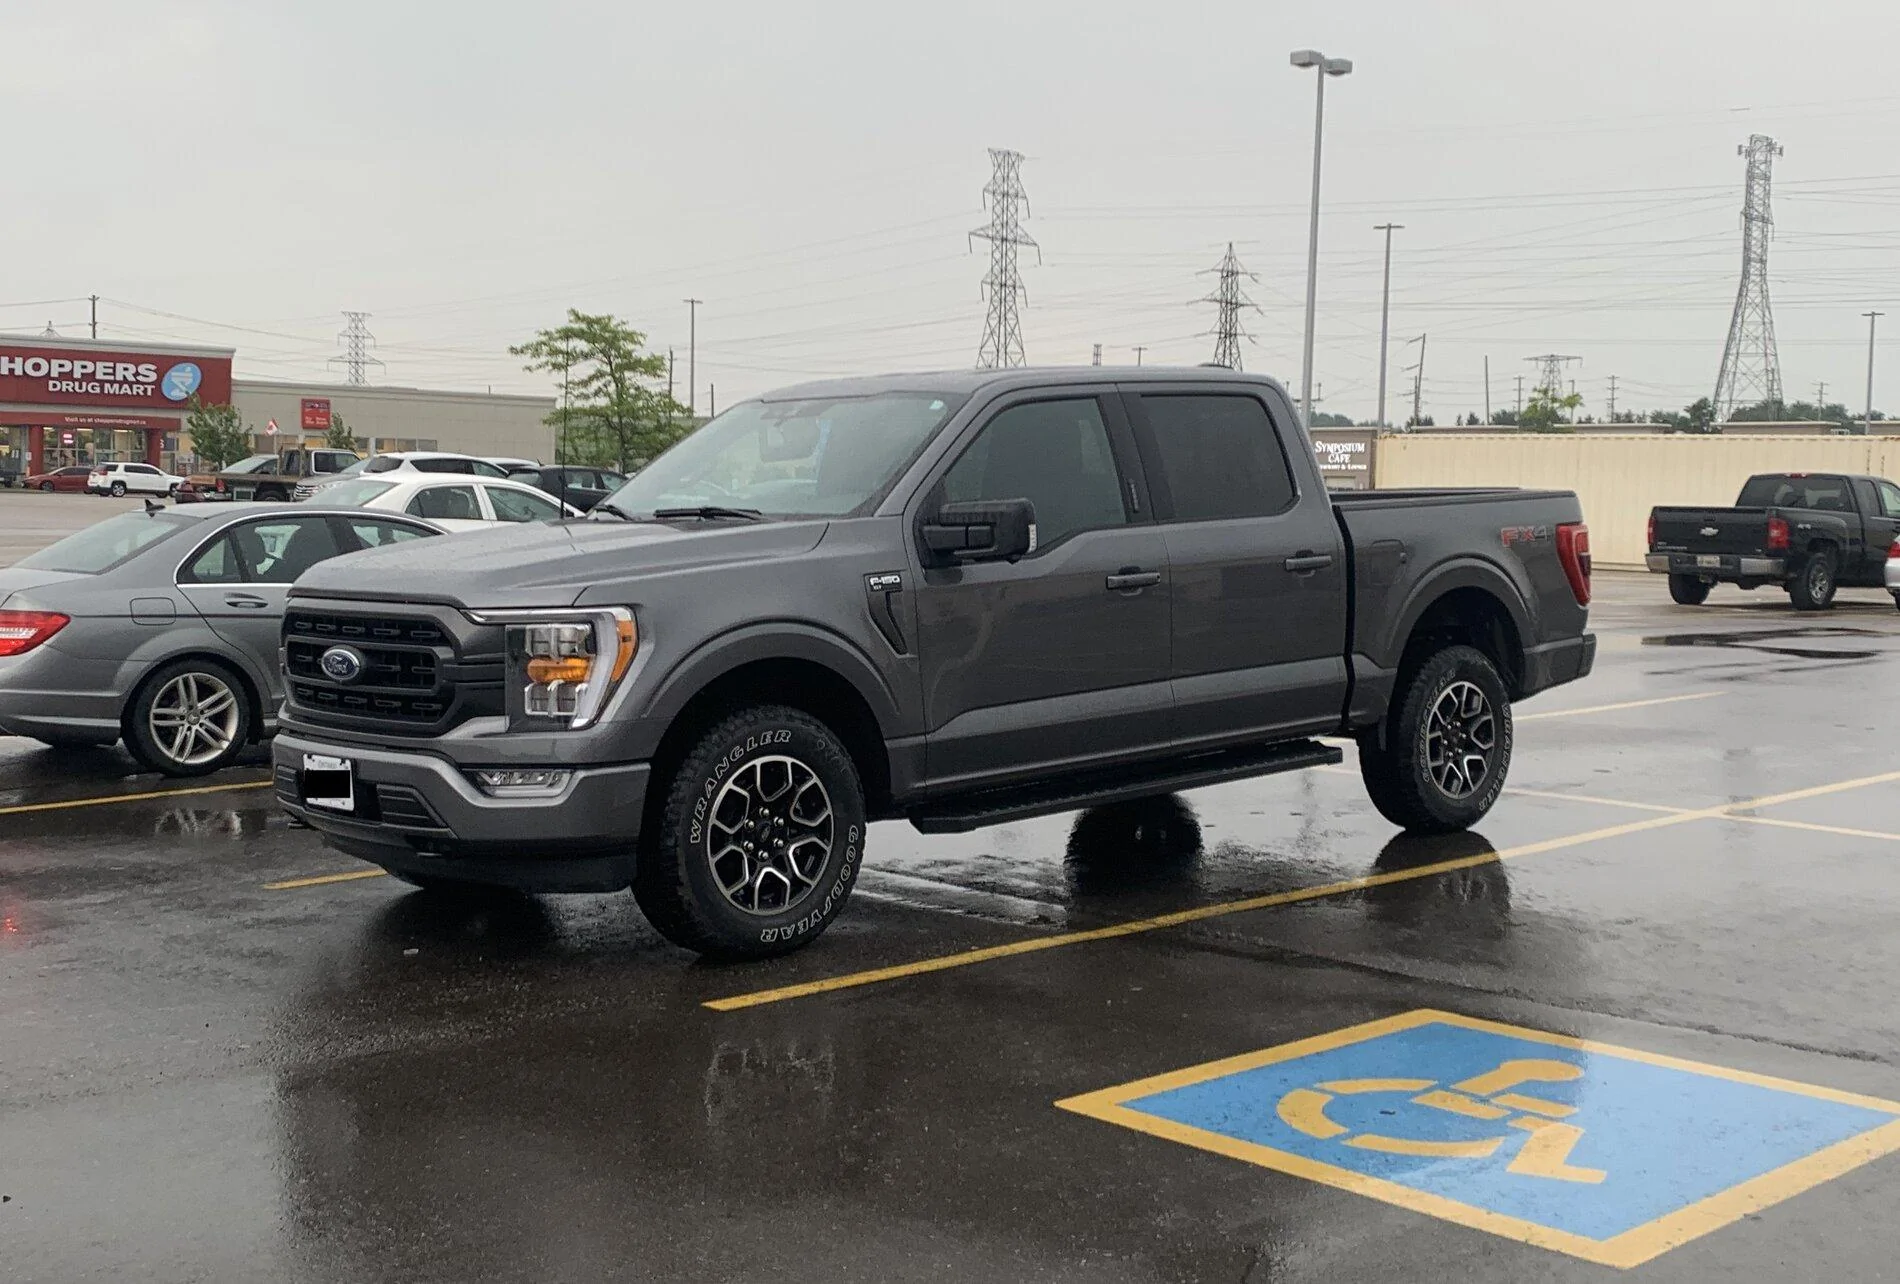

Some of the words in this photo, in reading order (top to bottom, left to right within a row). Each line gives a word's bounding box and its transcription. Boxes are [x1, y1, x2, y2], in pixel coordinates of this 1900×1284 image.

[48, 379, 100, 394] DRUG
[103, 382, 156, 396] MART
[1500, 525, 1547, 548] FX4
[869, 575, 901, 586] F-150
[689, 728, 792, 845] WRANGLER
[760, 823, 859, 943] GOODYEAR
